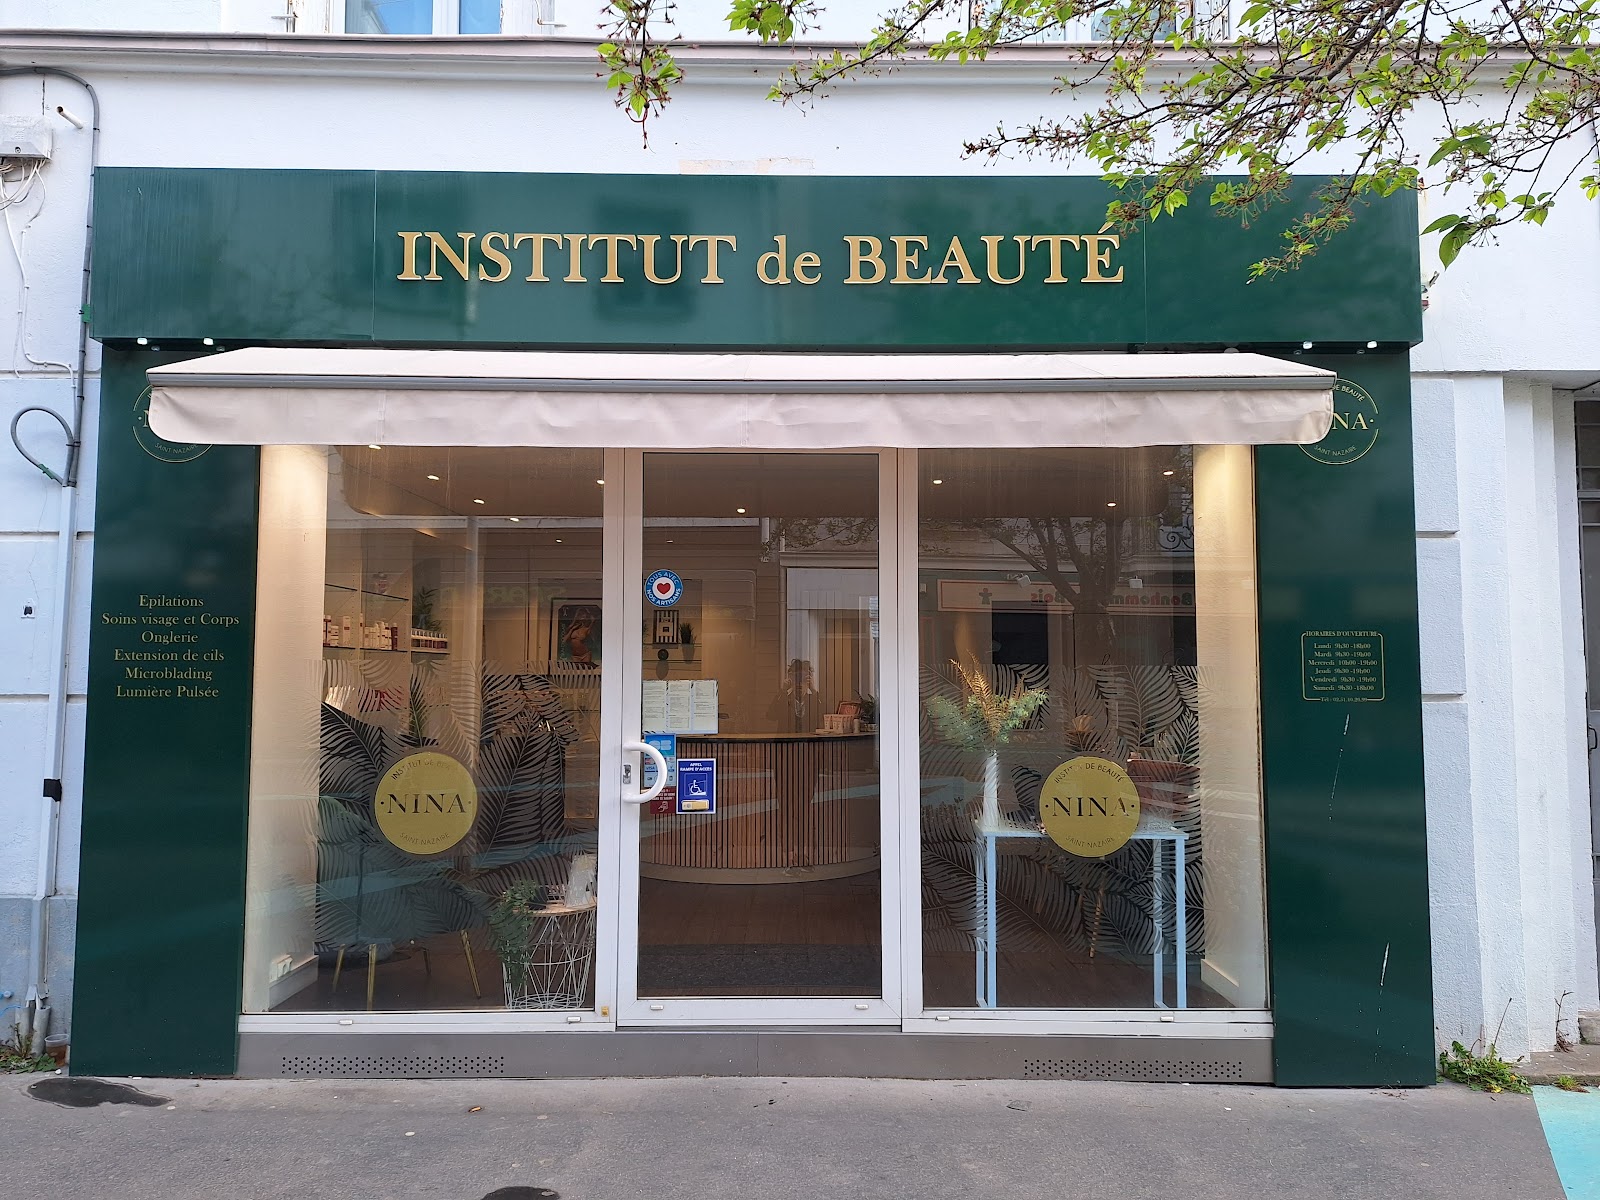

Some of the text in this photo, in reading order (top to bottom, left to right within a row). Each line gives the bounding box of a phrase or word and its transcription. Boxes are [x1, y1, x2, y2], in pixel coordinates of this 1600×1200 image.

[396, 221, 1124, 285] INSTITUT de BEAUTÉ
[1331, 412, 1369, 430] NA
[647, 571, 680, 586] TOUS AVEC
[139, 594, 204, 609] Epilations
[646, 588, 681, 606] NOS ARTISANS
[101, 612, 240, 627] Soins visage et Corps
[141, 630, 198, 645] Onglerie
[114, 648, 225, 661] Extension de cils
[125, 667, 213, 681] Microblading
[116, 685, 219, 698] Lumière Pulsée
[1085, 762, 1096, 770] DE
